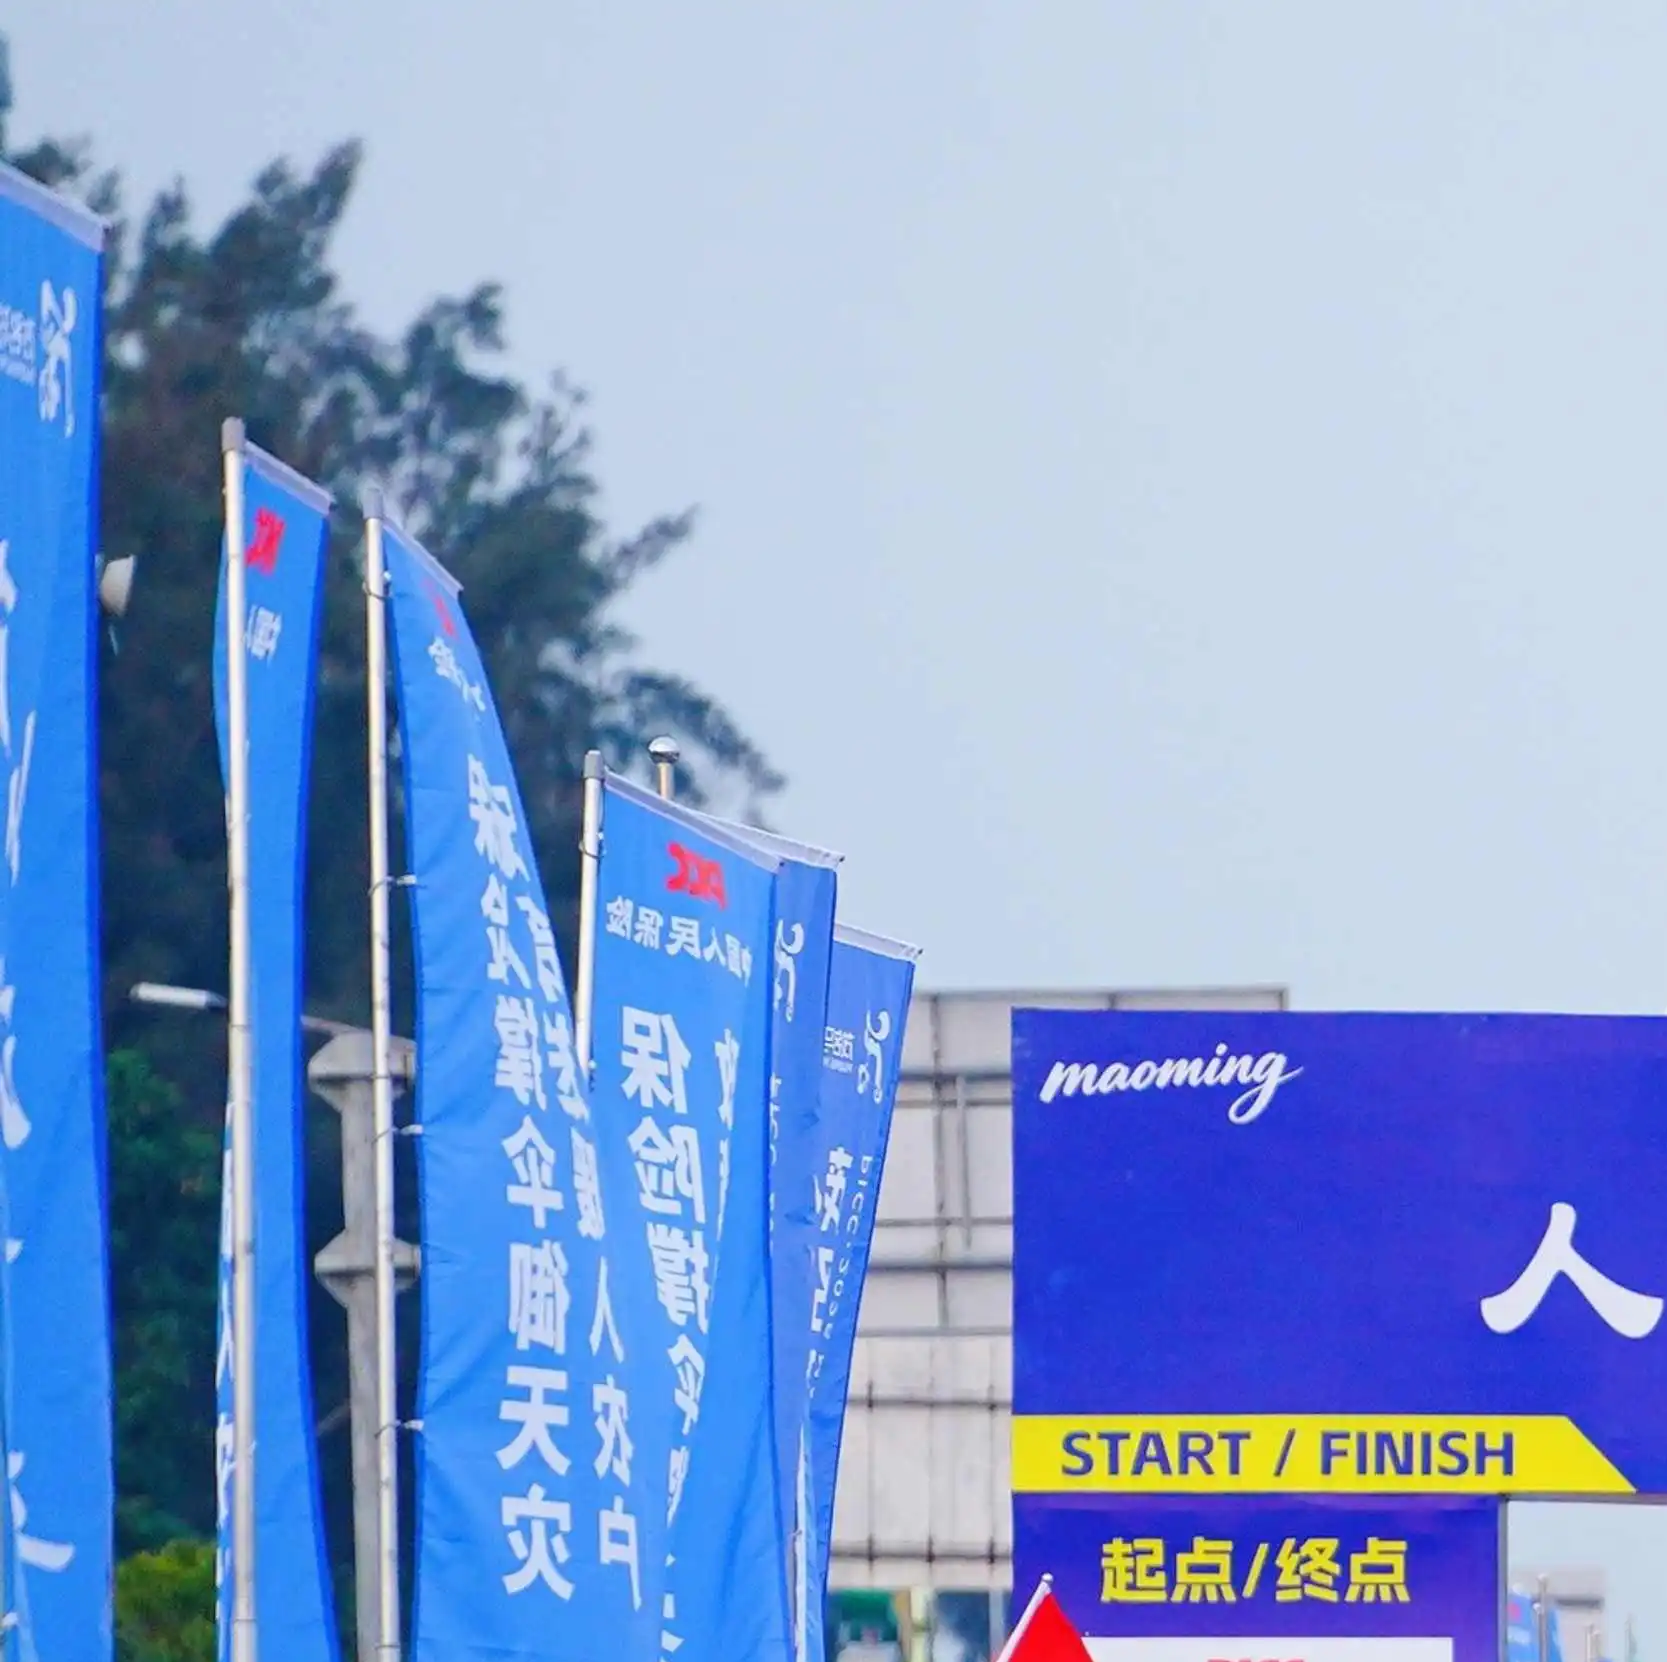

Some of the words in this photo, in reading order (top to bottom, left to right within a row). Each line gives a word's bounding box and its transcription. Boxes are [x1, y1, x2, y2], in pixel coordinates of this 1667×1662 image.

[1040, 1044, 1304, 1124] maoming
[1061, 1431, 1249, 1477] START
[1320, 1429, 1516, 1478] FINISH
[1101, 1537, 1410, 1602] 起点/终点
